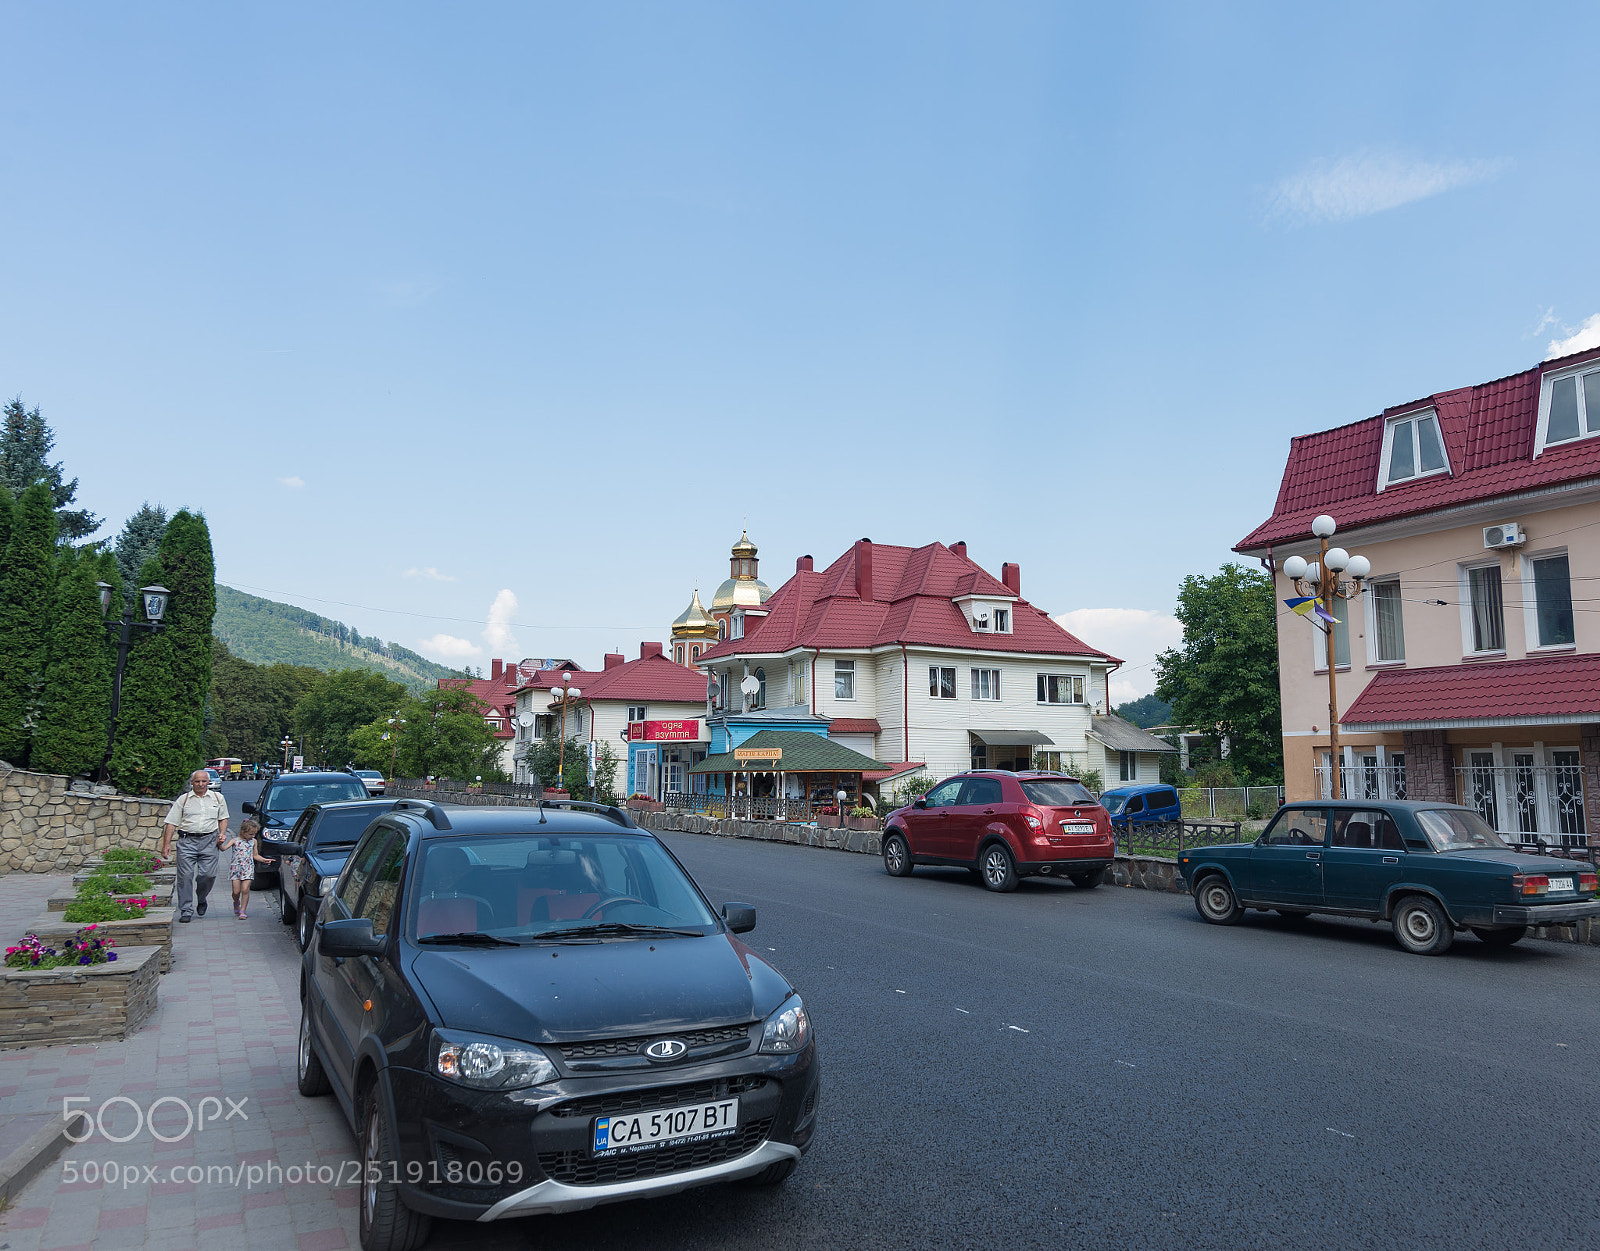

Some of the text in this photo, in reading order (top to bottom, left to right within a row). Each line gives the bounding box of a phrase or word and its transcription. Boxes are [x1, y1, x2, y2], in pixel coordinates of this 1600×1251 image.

[611, 1102, 733, 1143] CA 5107 BT
[596, 1137, 607, 1146] UA
